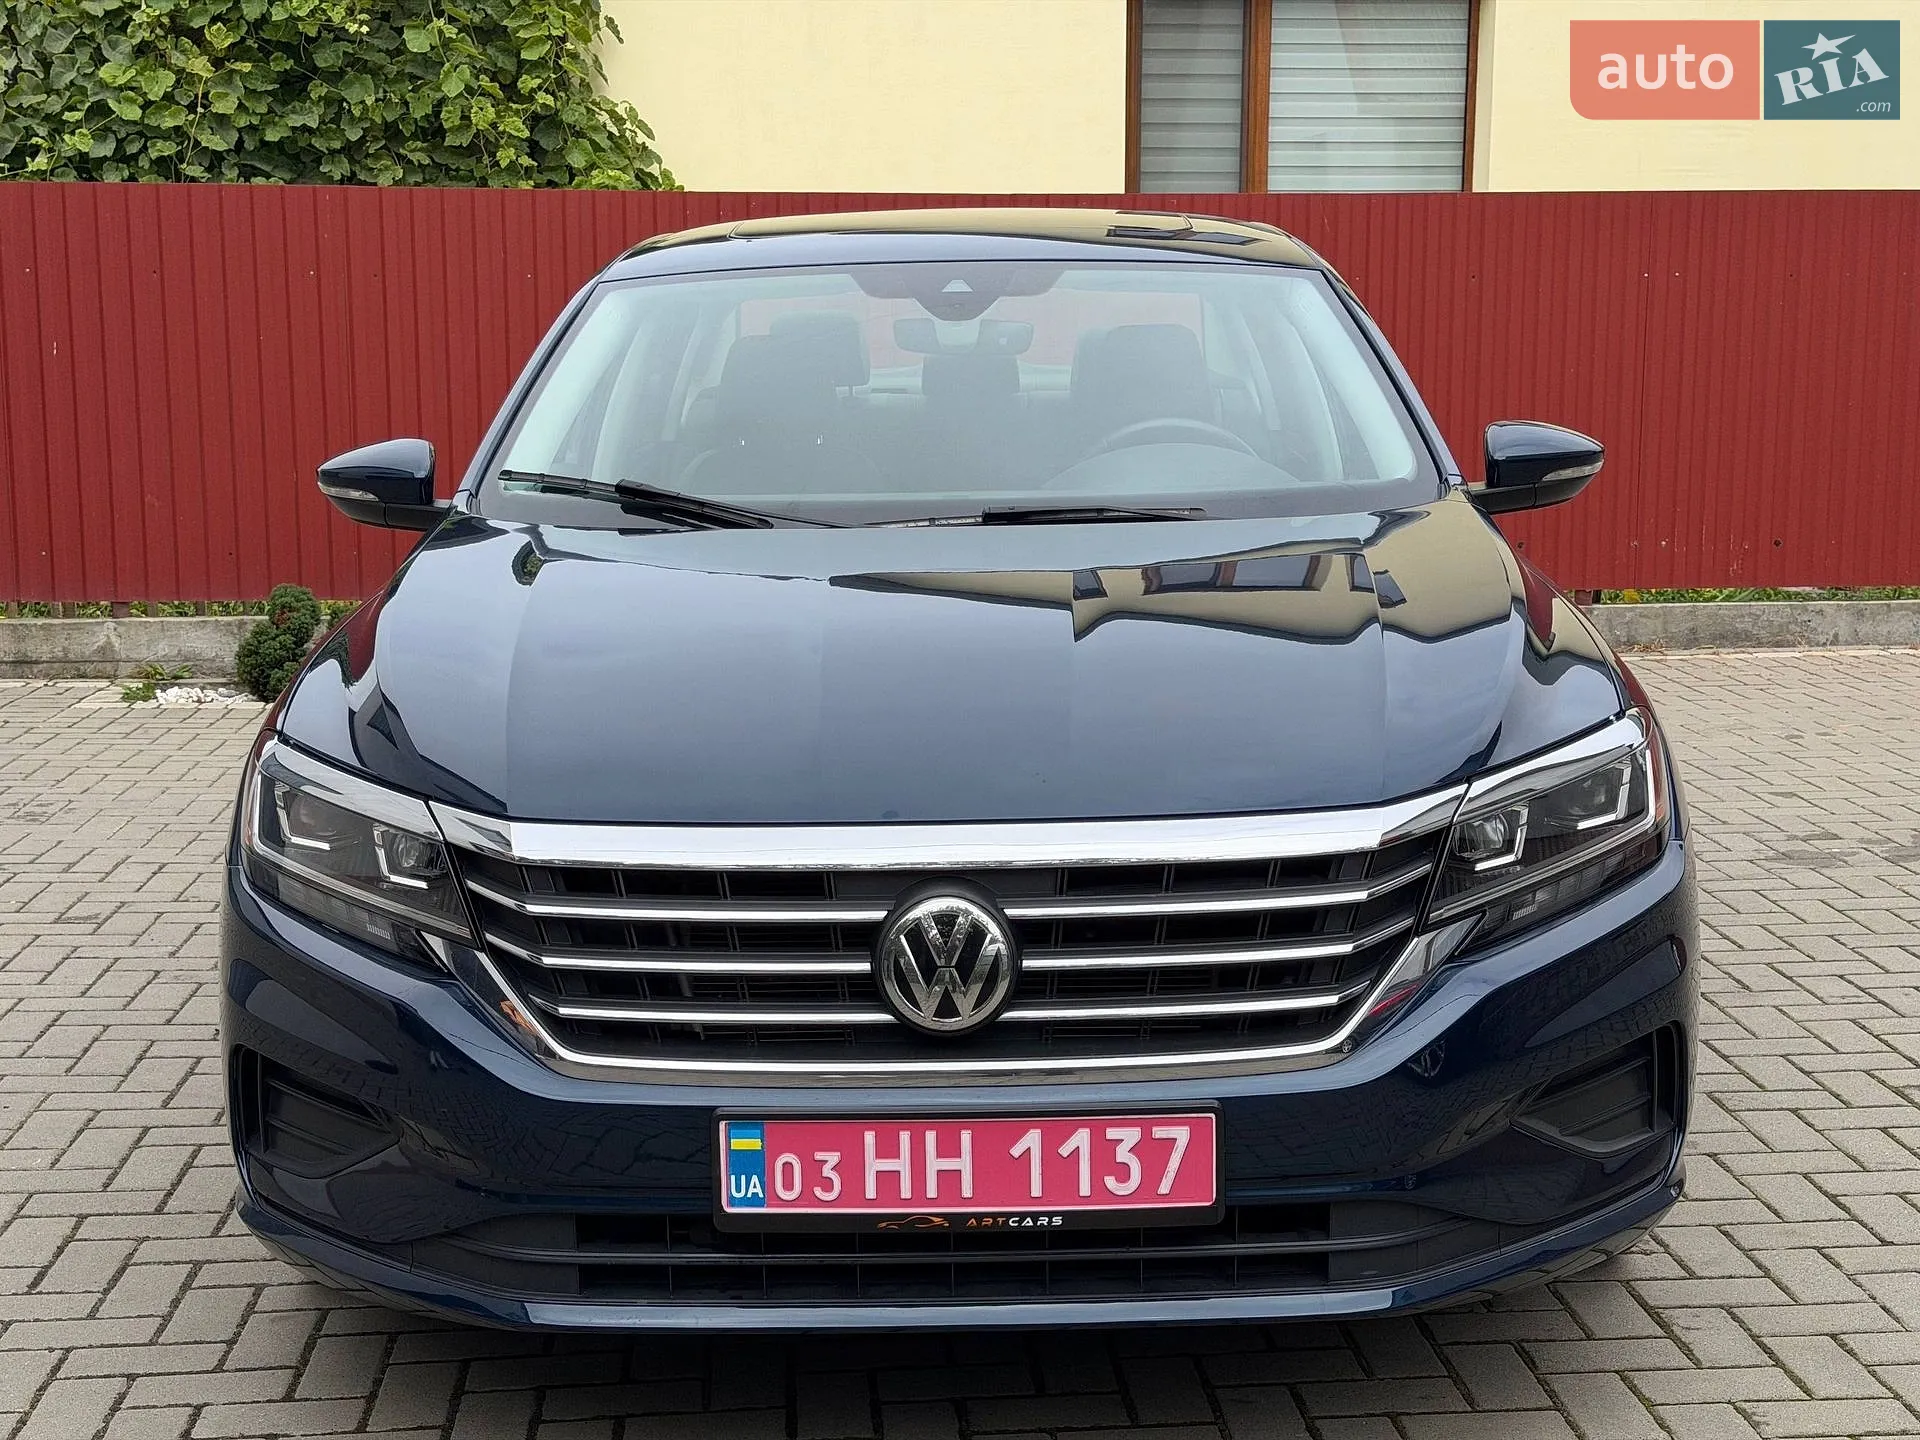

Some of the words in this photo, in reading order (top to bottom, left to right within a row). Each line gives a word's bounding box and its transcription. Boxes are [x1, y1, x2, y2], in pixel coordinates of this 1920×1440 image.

[774, 1151, 842, 1202] 03
[864, 1129, 974, 1200] HH
[1009, 1126, 1191, 1198] 1137
[731, 1174, 764, 1199] UA
[966, 1215, 1064, 1227] ARTCARS
